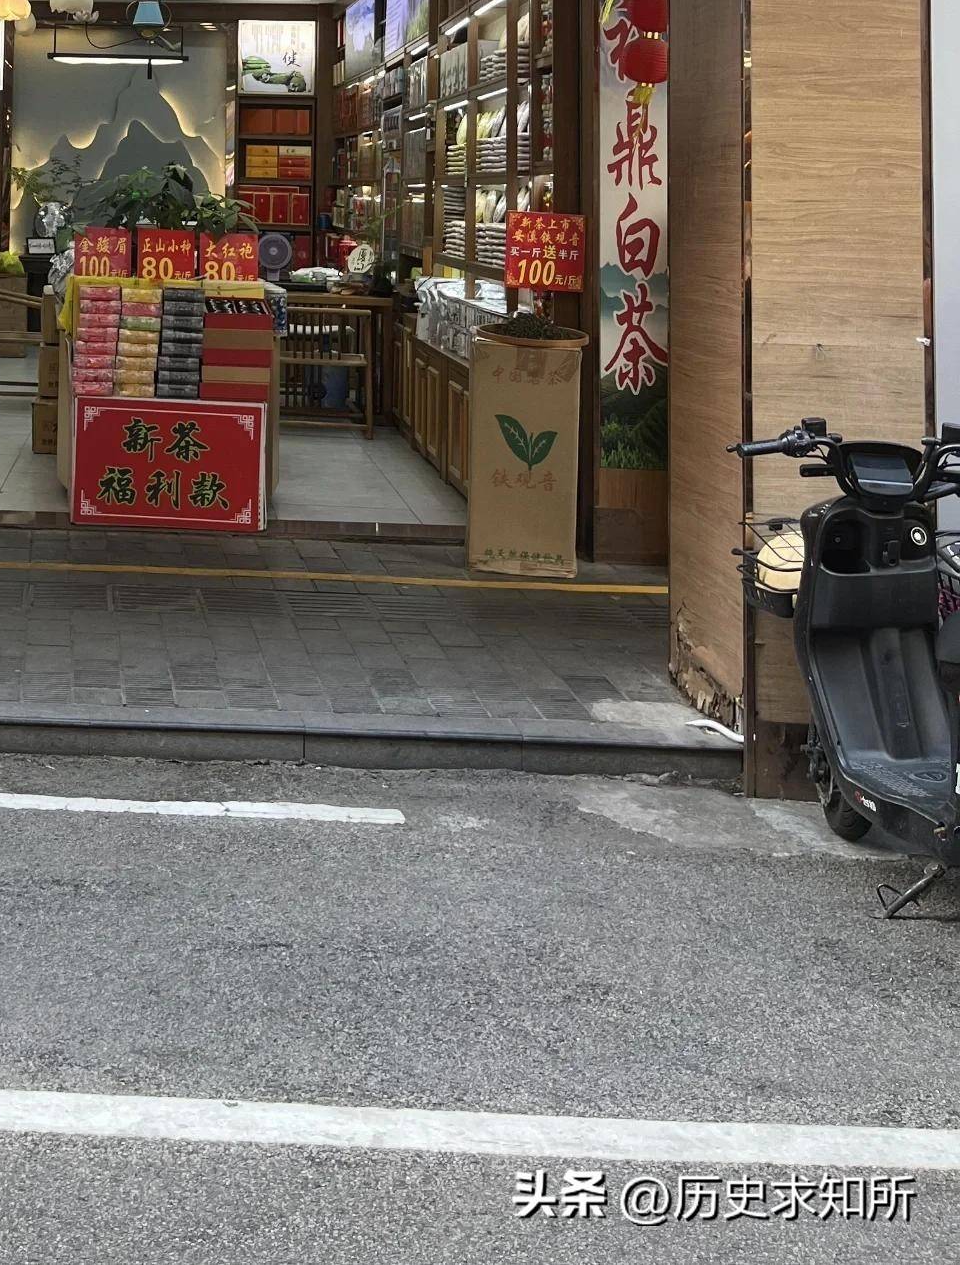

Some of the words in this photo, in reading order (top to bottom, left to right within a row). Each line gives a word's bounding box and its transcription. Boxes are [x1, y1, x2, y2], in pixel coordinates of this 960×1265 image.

[520, 216, 571, 232] 新茶上市
[142, 237, 192, 256] 正山小种
[511, 229, 580, 247] 安溪铁观音
[205, 240, 255, 260] 大红袍
[510, 244, 579, 261] 买一斤送半斤
[518, 259, 578, 286] 100元/斤
[121, 417, 209, 462] 新茶
[96, 466, 230, 511] 福利款
[489, 468, 558, 492] 铁观音
